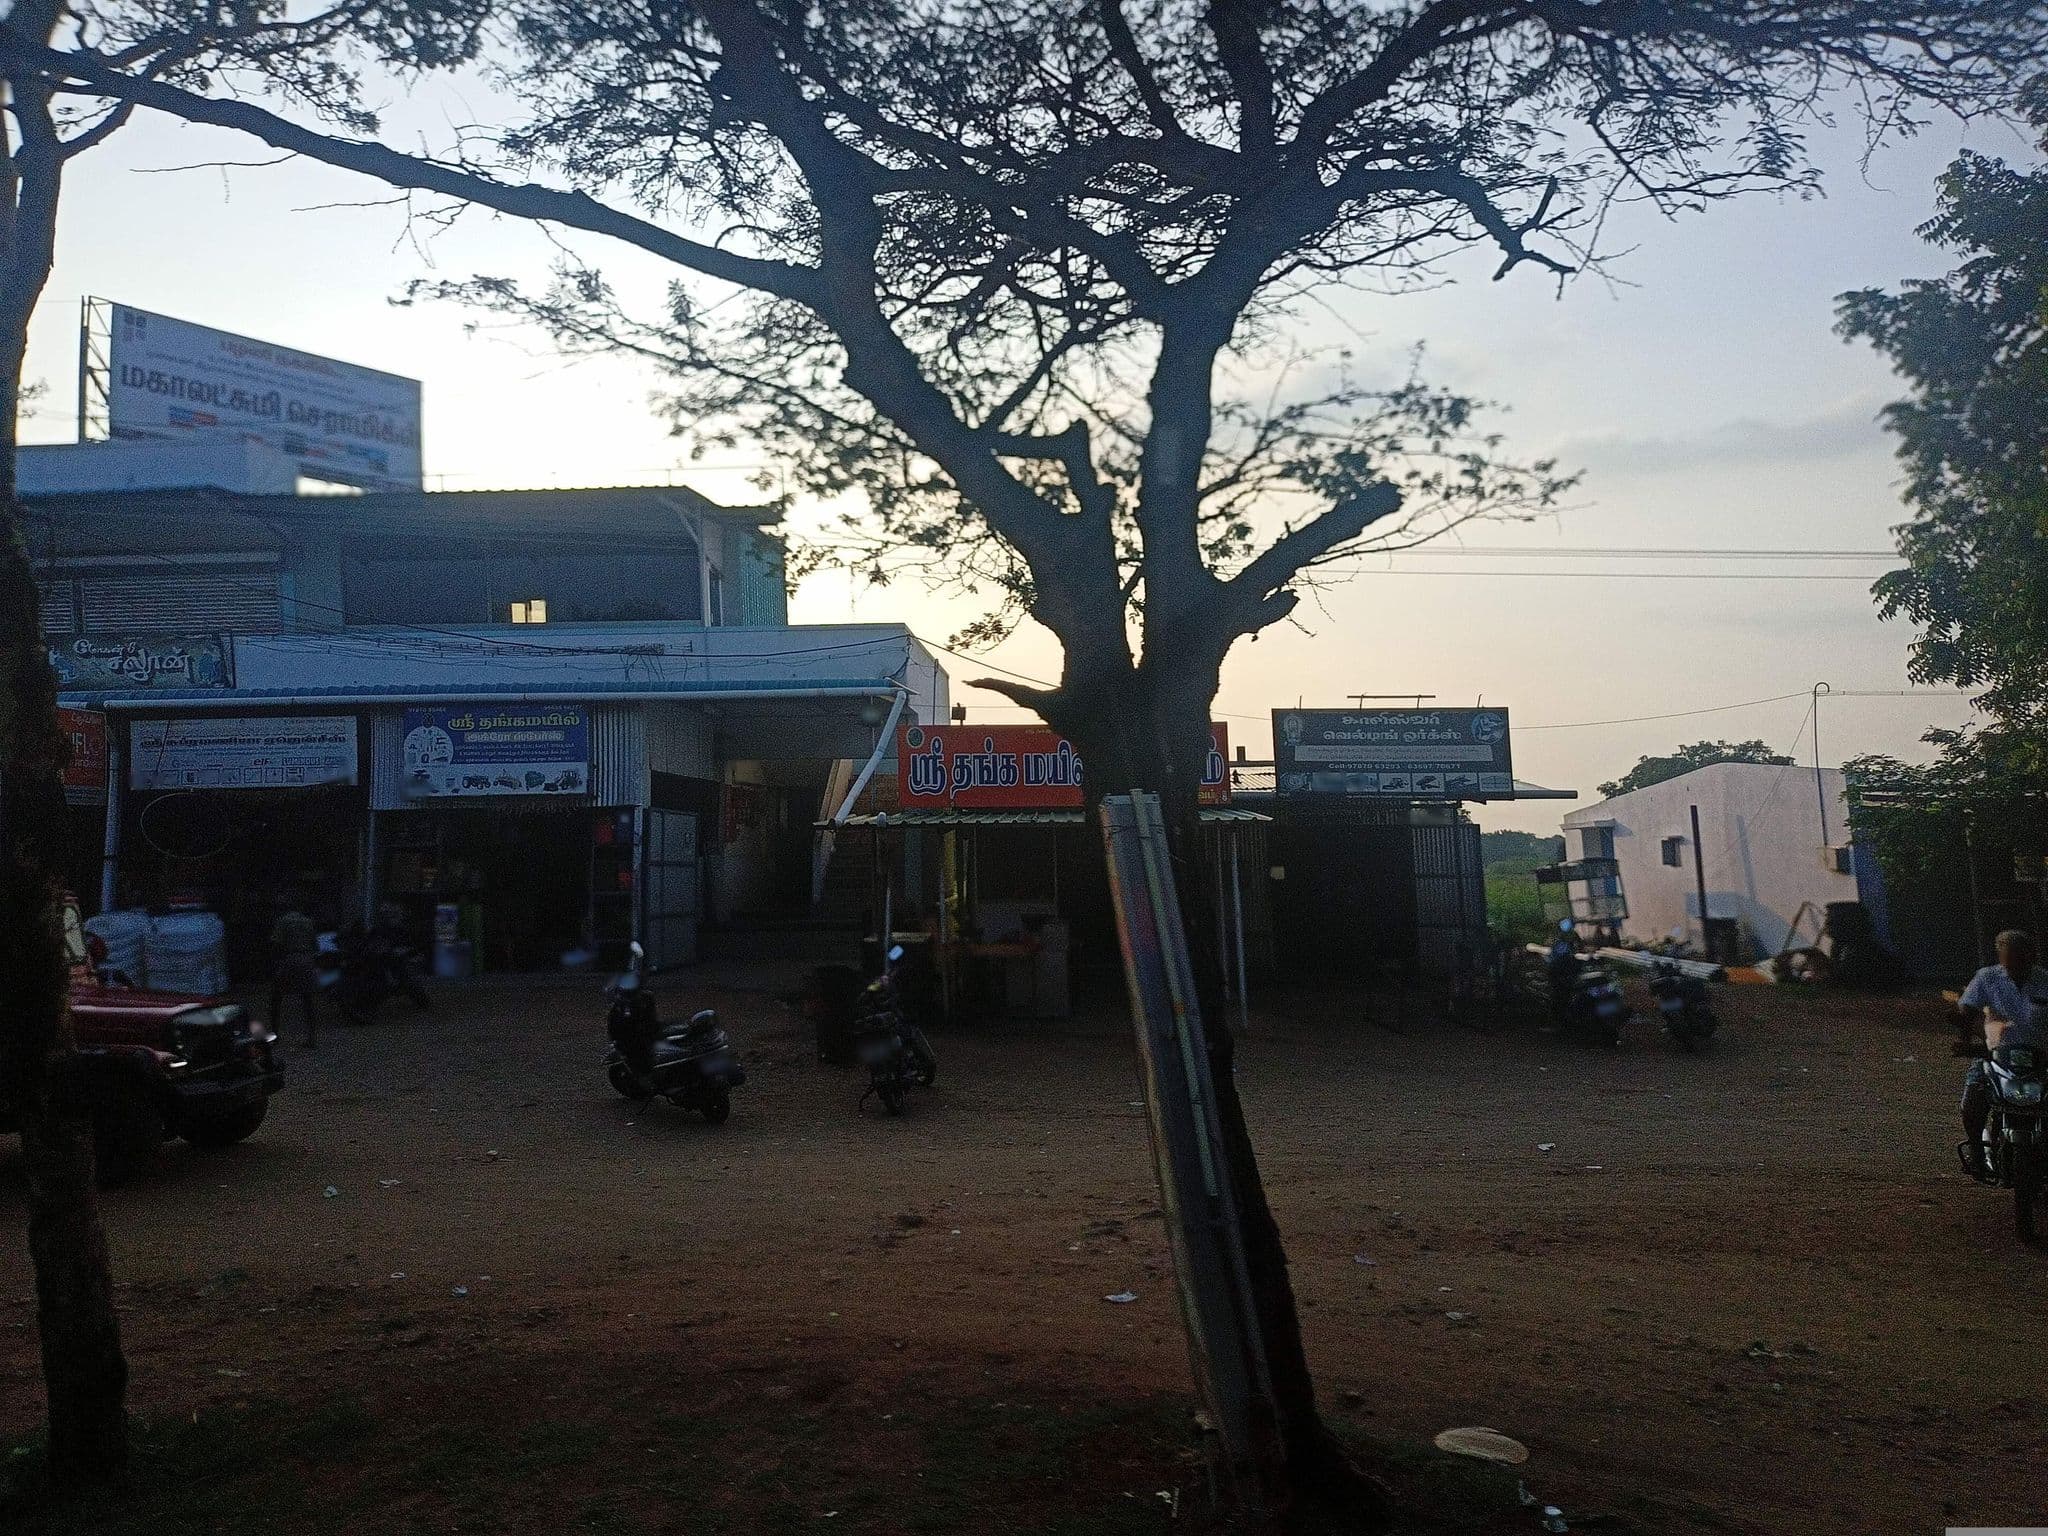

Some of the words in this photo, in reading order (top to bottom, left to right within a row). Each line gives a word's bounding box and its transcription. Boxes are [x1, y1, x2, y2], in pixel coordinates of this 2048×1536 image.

[121, 363, 282, 422] மகாலட்சுமி
[448, 713, 476, 731] ஸ்ரீ
[479, 711, 581, 731] தங்கமயில்
[908, 736, 948, 796] ஸ்ரீ
[950, 736, 1019, 800] தங்க
